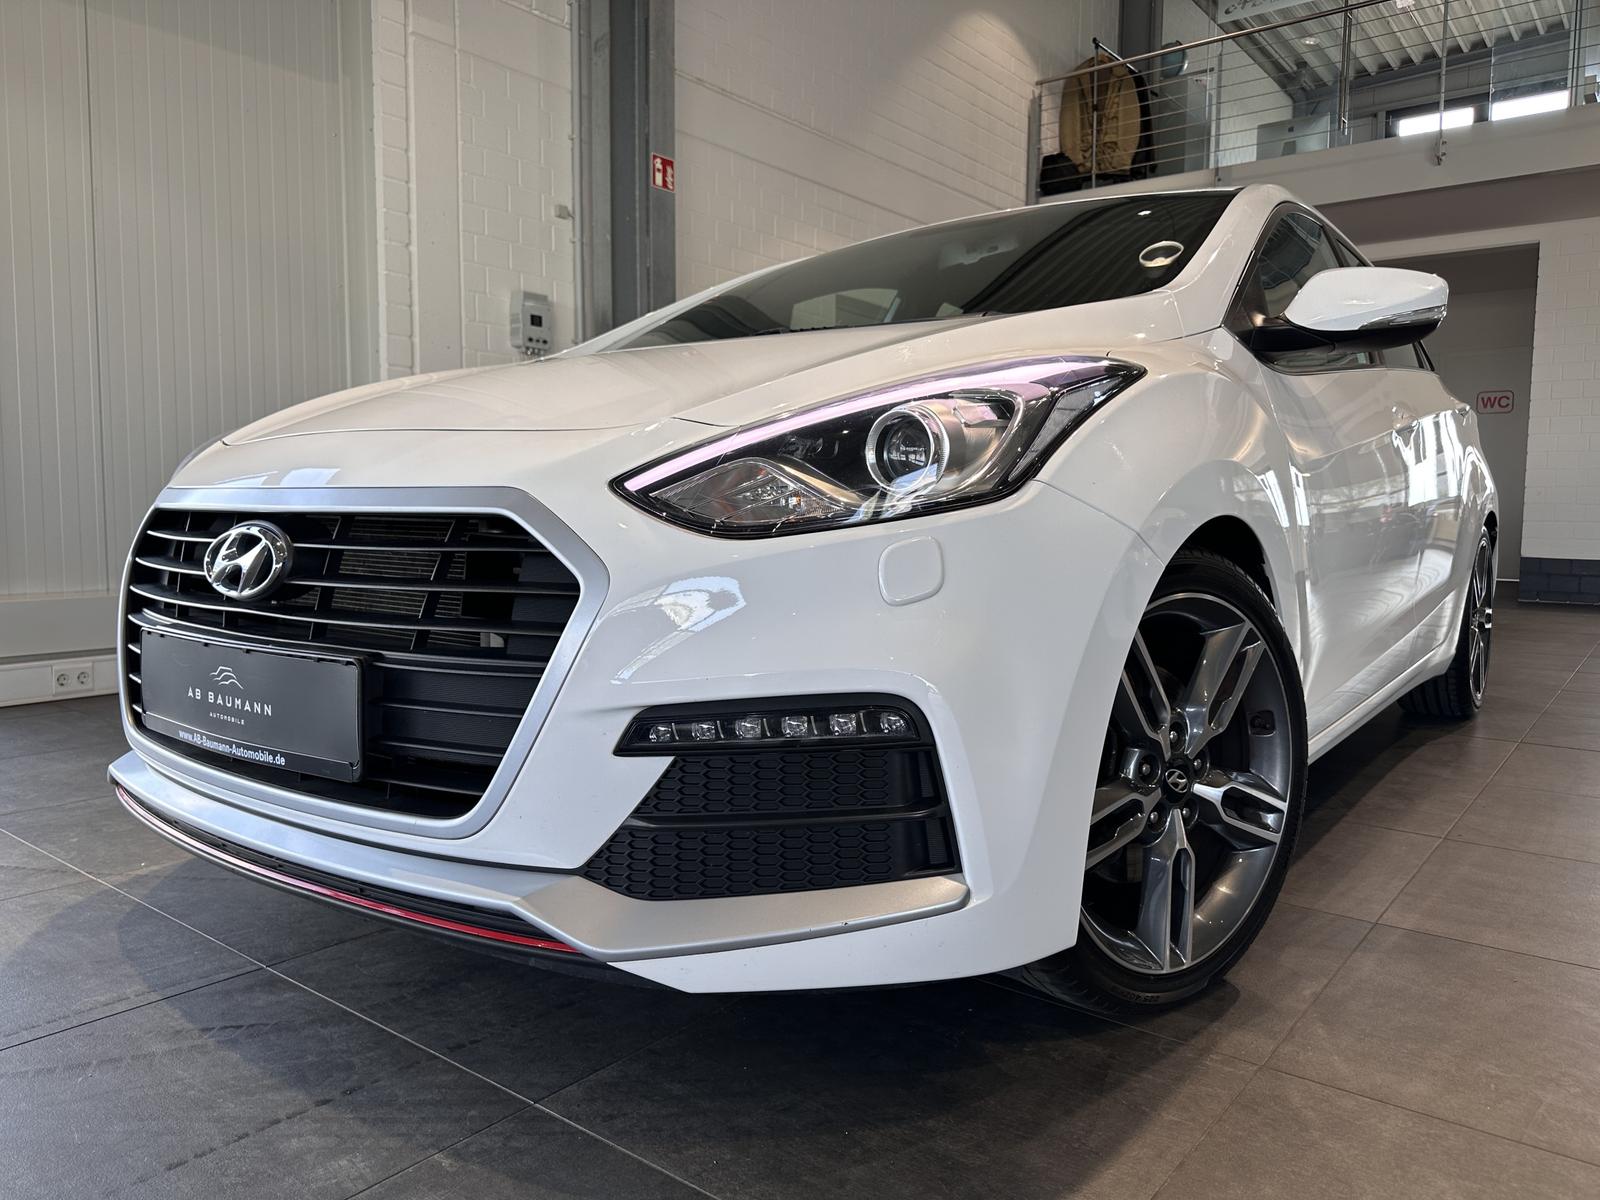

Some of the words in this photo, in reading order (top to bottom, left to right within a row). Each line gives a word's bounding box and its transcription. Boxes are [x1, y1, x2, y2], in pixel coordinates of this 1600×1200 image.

[1481, 395, 1510, 409] WC
[187, 686, 201, 700] AB
[208, 691, 272, 716] BAUMANN
[209, 711, 245, 725] AUTOMOBILE
[178, 730, 286, 766] www.AB-Baumann-Automobile.de
